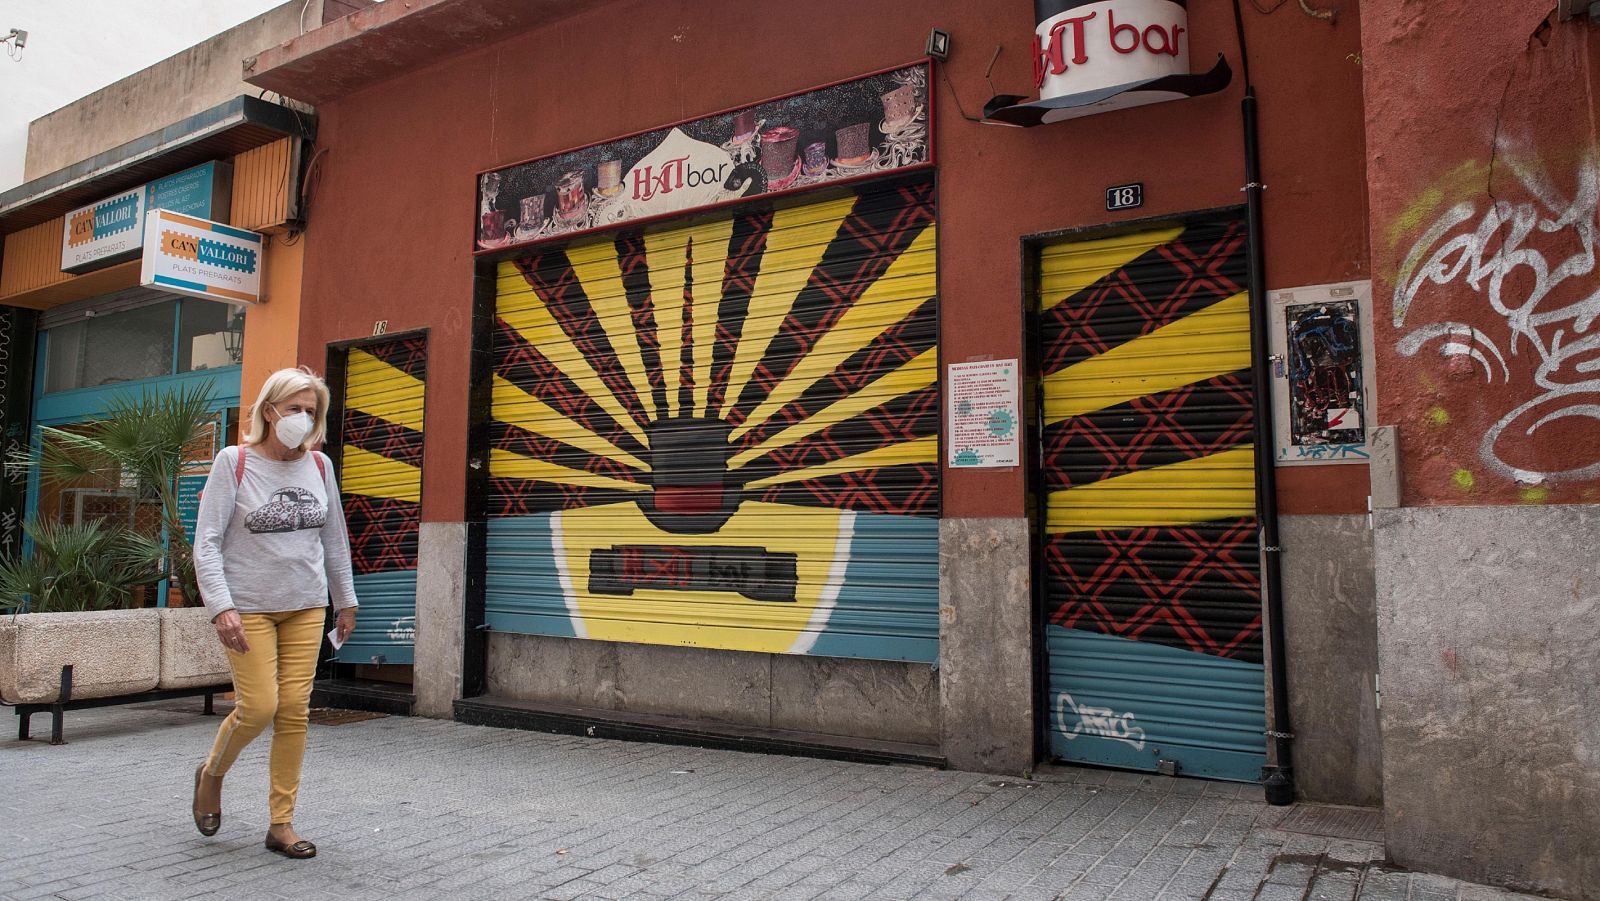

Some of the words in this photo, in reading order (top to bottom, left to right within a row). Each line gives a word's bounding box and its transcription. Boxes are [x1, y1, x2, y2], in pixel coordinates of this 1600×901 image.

[1108, 9, 1185, 57] bar
[632, 154, 691, 201] HAT
[686, 163, 728, 188] bar
[1113, 188, 1134, 207] 18
[75, 219, 94, 235] CA'N
[95, 204, 132, 229] VALLORI
[75, 251, 93, 262] PLATS
[94, 240, 127, 257] PREPARATS
[171, 238, 198, 254] CA'N
[200, 244, 248, 265] VALLORI
[172, 263, 197, 275] PLATS
[198, 269, 242, 285] PREPARATS
[375, 321, 386, 335] 18
